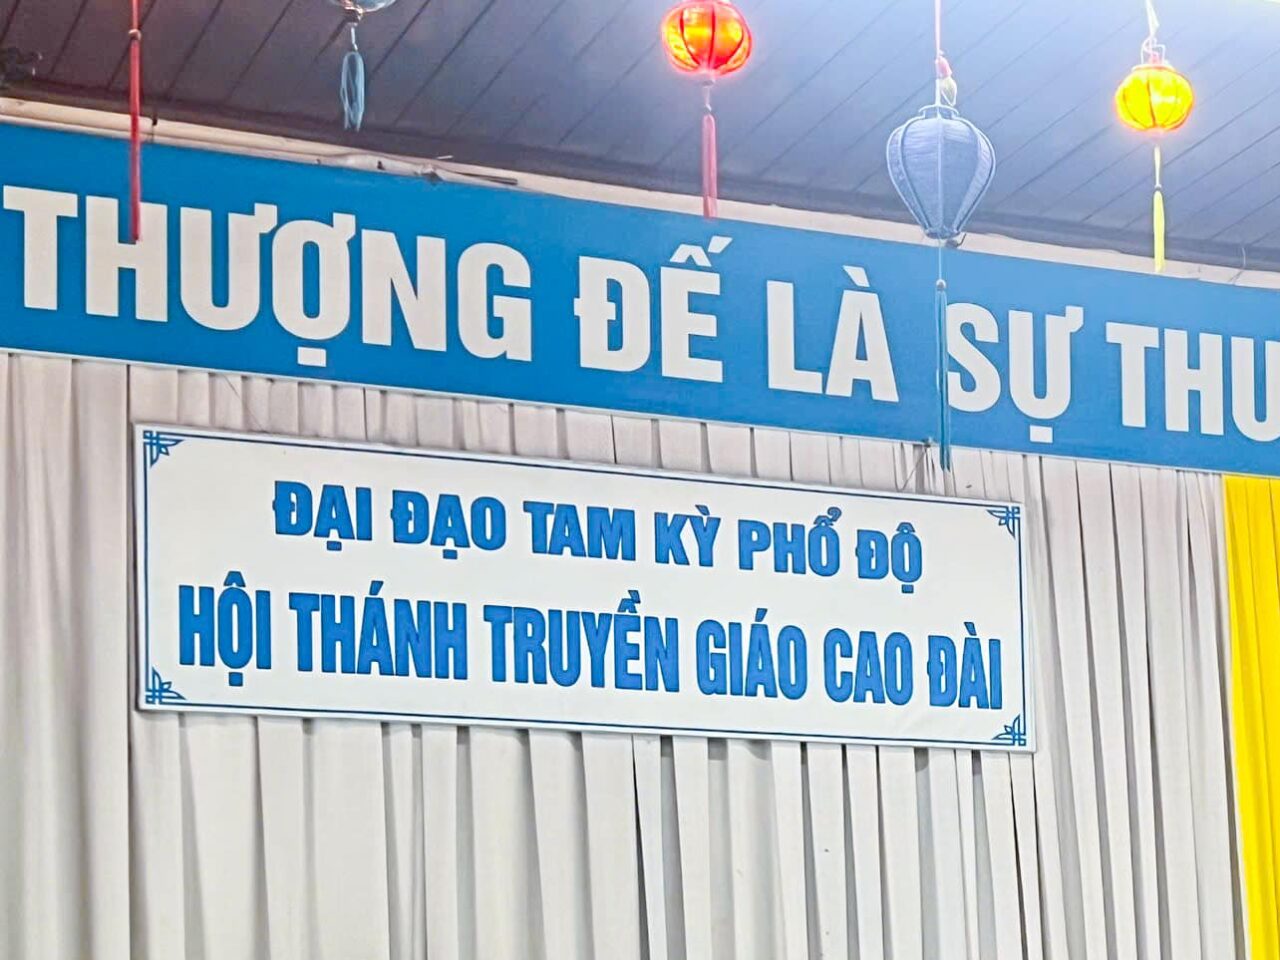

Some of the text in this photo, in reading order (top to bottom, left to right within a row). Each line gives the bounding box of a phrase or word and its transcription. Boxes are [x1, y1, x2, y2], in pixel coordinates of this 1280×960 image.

[3, 185, 532, 367] THƯỢNG
[574, 236, 733, 383] ĐẾ
[765, 265, 900, 403] LÀ
[947, 303, 1084, 444] SỰ
[273, 481, 923, 594] ĐẠI ĐẠO TAM KỲ PHỔ ĐỘ
[178, 571, 1003, 710] HỘI THÁNH TRUYỀN GIÁO CAO ĐÀI
